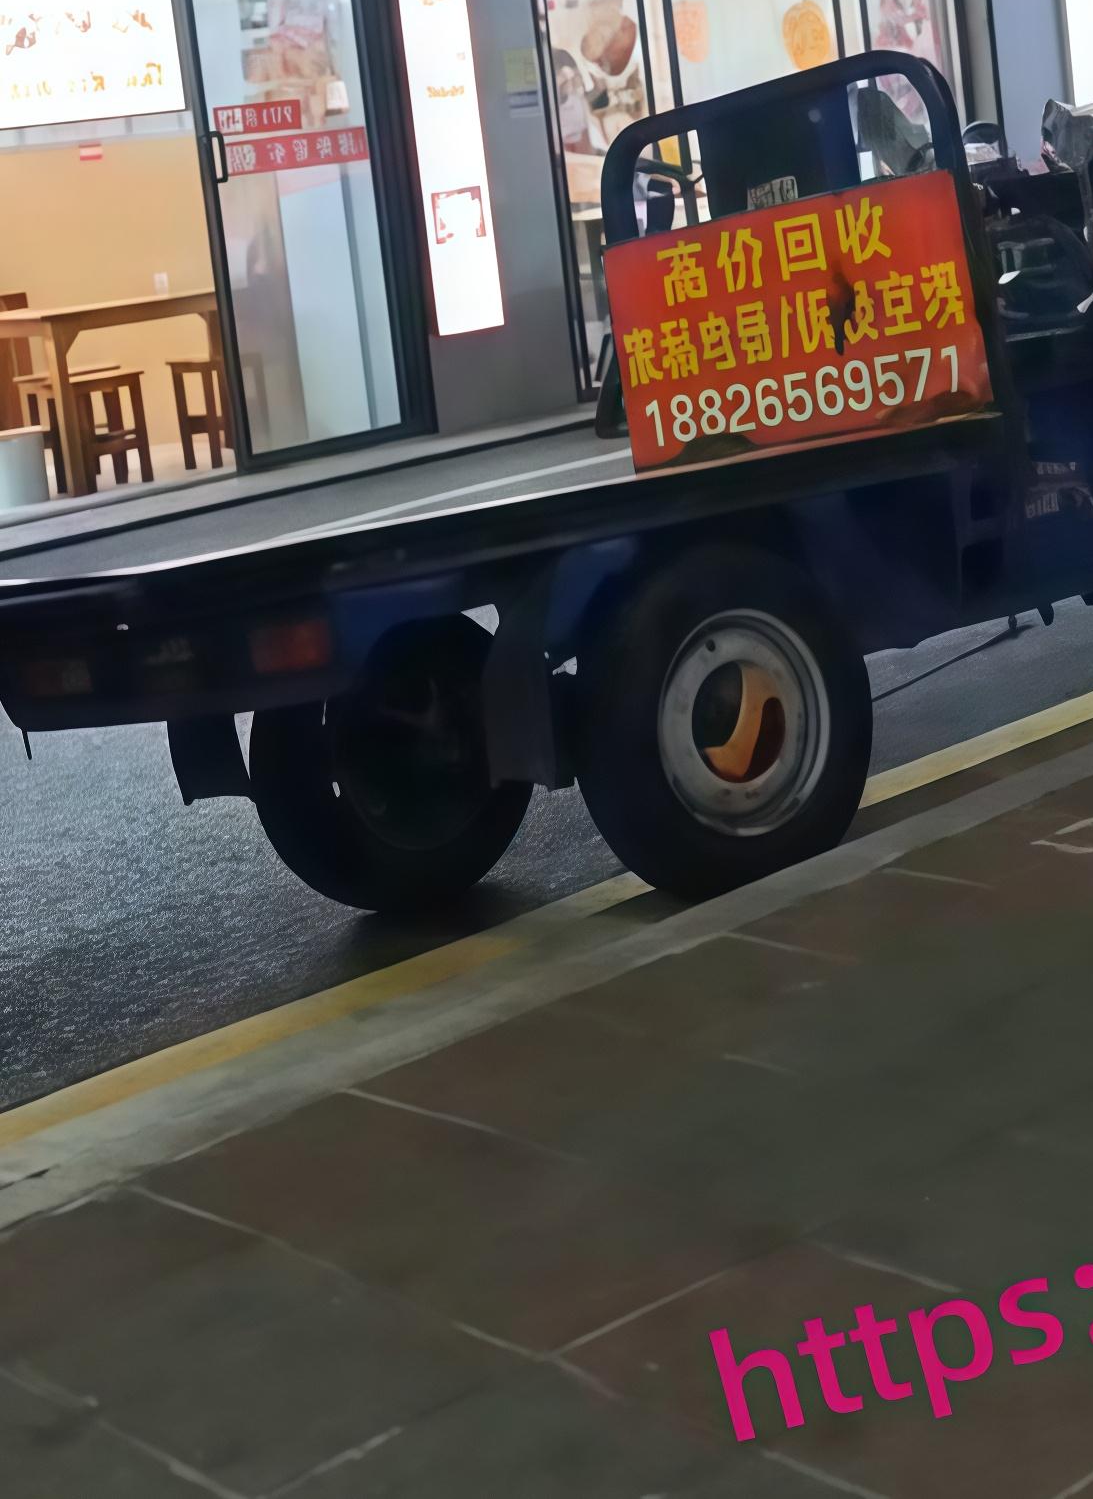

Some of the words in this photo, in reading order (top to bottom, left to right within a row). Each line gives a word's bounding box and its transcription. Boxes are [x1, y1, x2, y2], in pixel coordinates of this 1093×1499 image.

[656, 197, 893, 306] 高价回收
[644, 344, 959, 447] 18826569571
